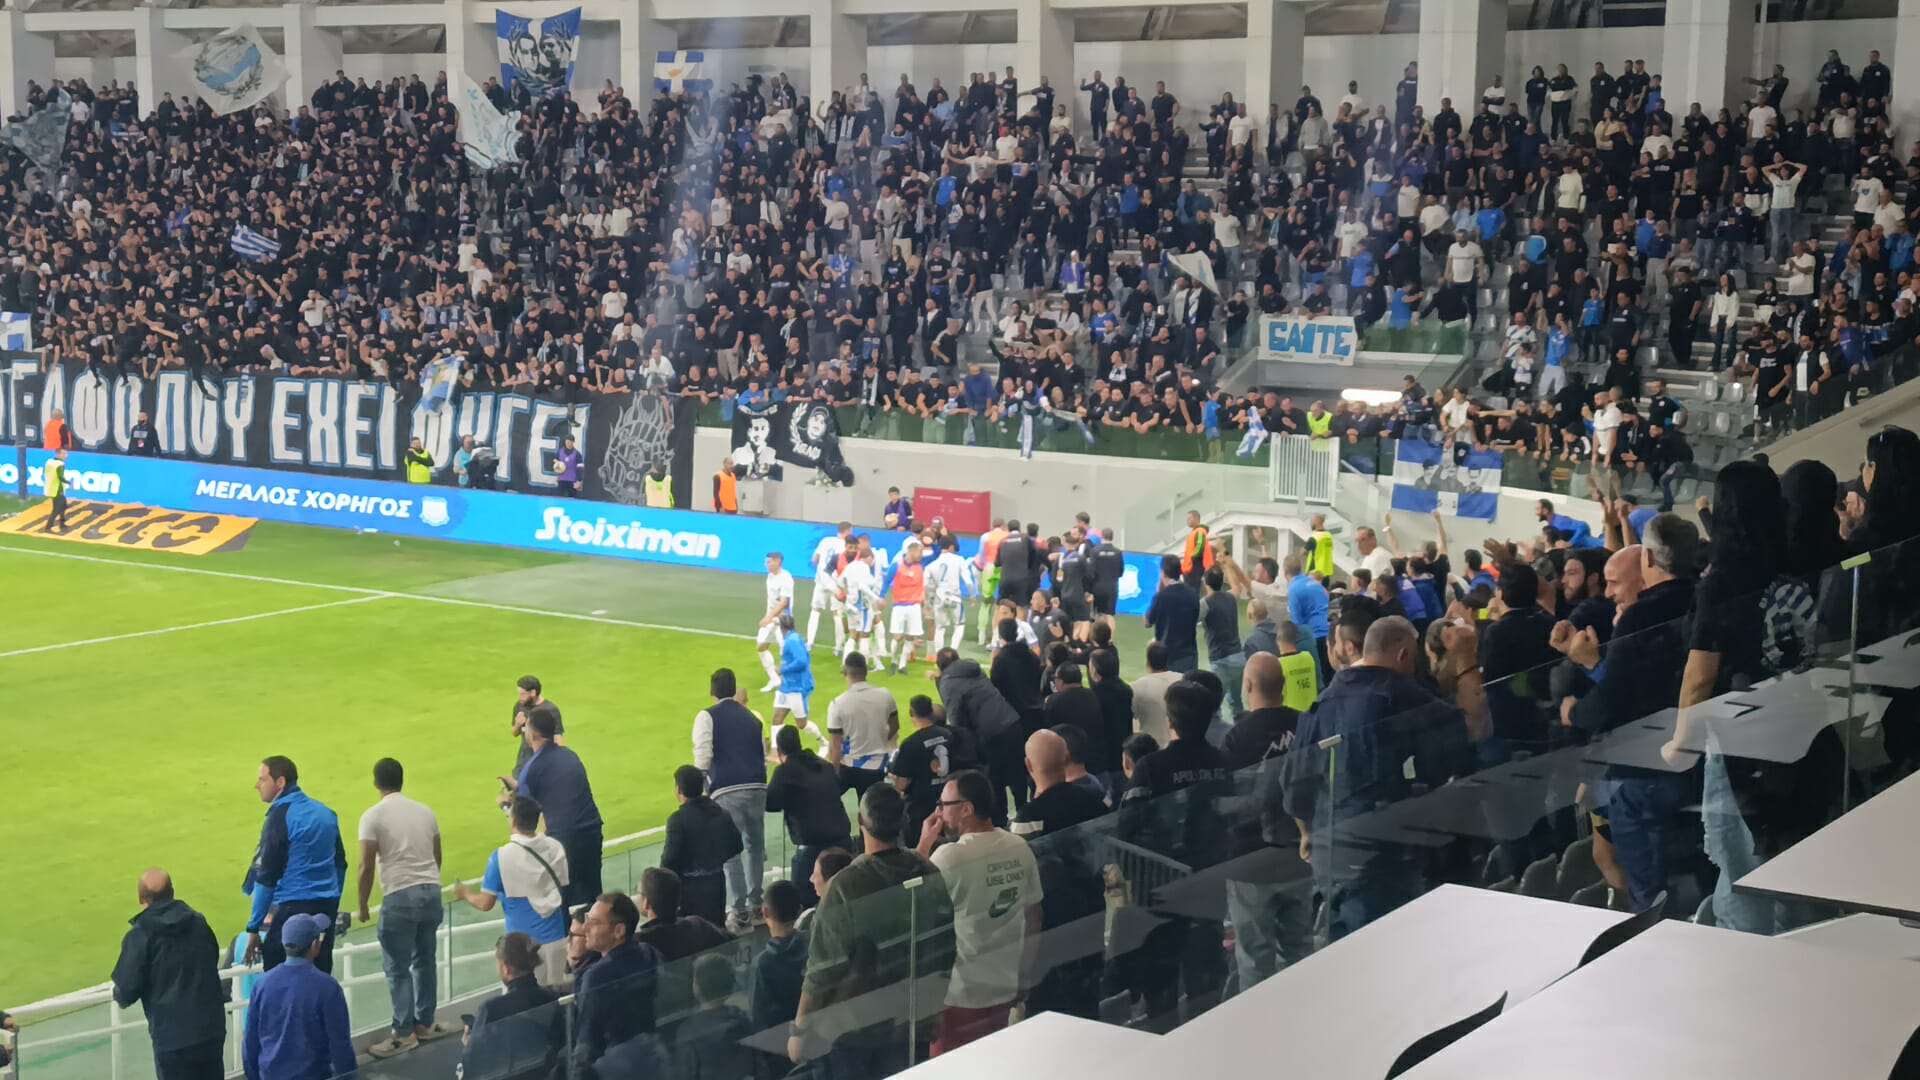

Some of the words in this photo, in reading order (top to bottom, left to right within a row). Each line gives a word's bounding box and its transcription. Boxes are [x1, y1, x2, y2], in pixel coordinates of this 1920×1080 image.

[270, 377, 400, 470] ΕΧΕΙ
[196, 479, 299, 506] ΜΕΓΑΛΟΣ
[302, 489, 413, 518] ΧΟΡΗΓΟΣ
[535, 507, 721, 559] Stoiximan
